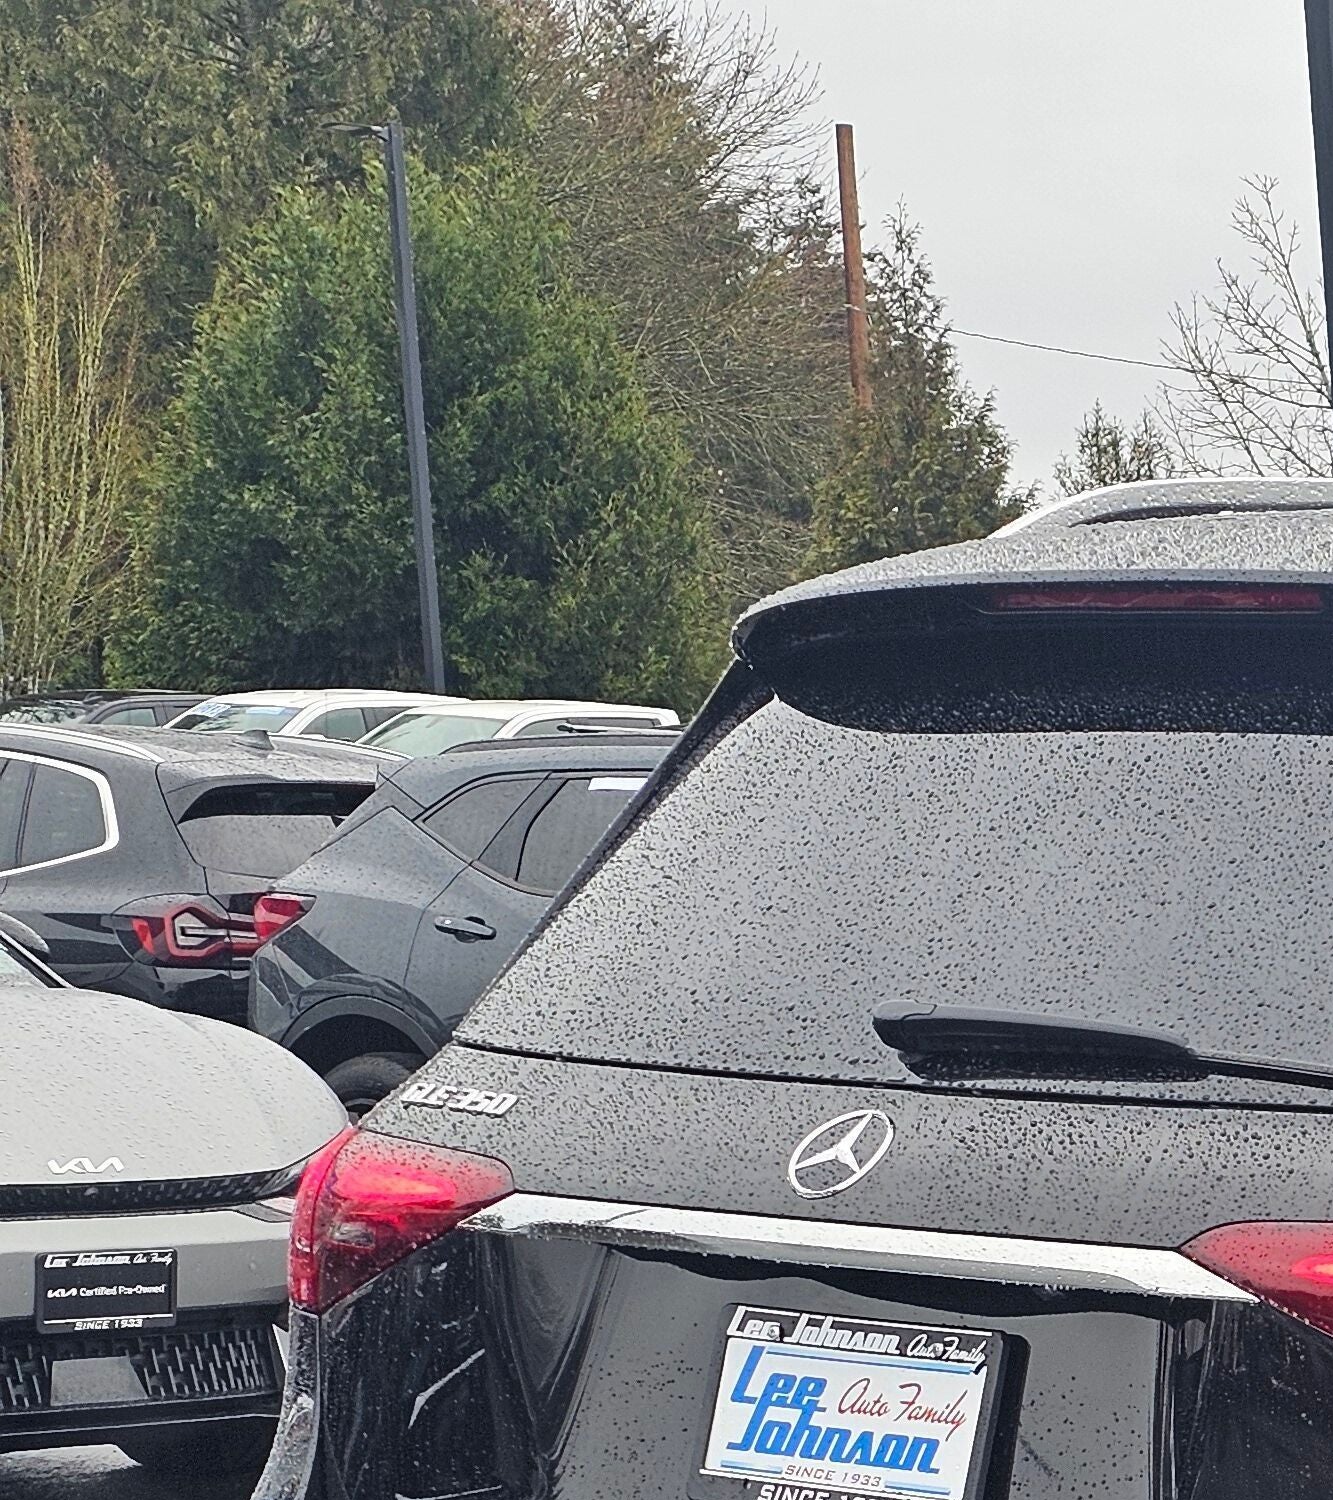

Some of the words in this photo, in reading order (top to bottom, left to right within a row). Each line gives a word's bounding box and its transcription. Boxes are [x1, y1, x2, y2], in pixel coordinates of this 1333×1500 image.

[79, 1285, 118, 1297] Certified
[74, 1319, 111, 1331] SINCE
[727, 1305, 781, 1341] Lee
[783, 1313, 900, 1355] Johnson
[907, 1333, 943, 1358] Auto
[942, 1336, 987, 1365] Family
[730, 1345, 828, 1413] Lee
[837, 1377, 891, 1417] Auto
[894, 1382, 968, 1443] Family
[725, 1405, 940, 1475] Johnson
[784, 1464, 836, 1482] SINCE
[843, 1471, 883, 1488] 1933
